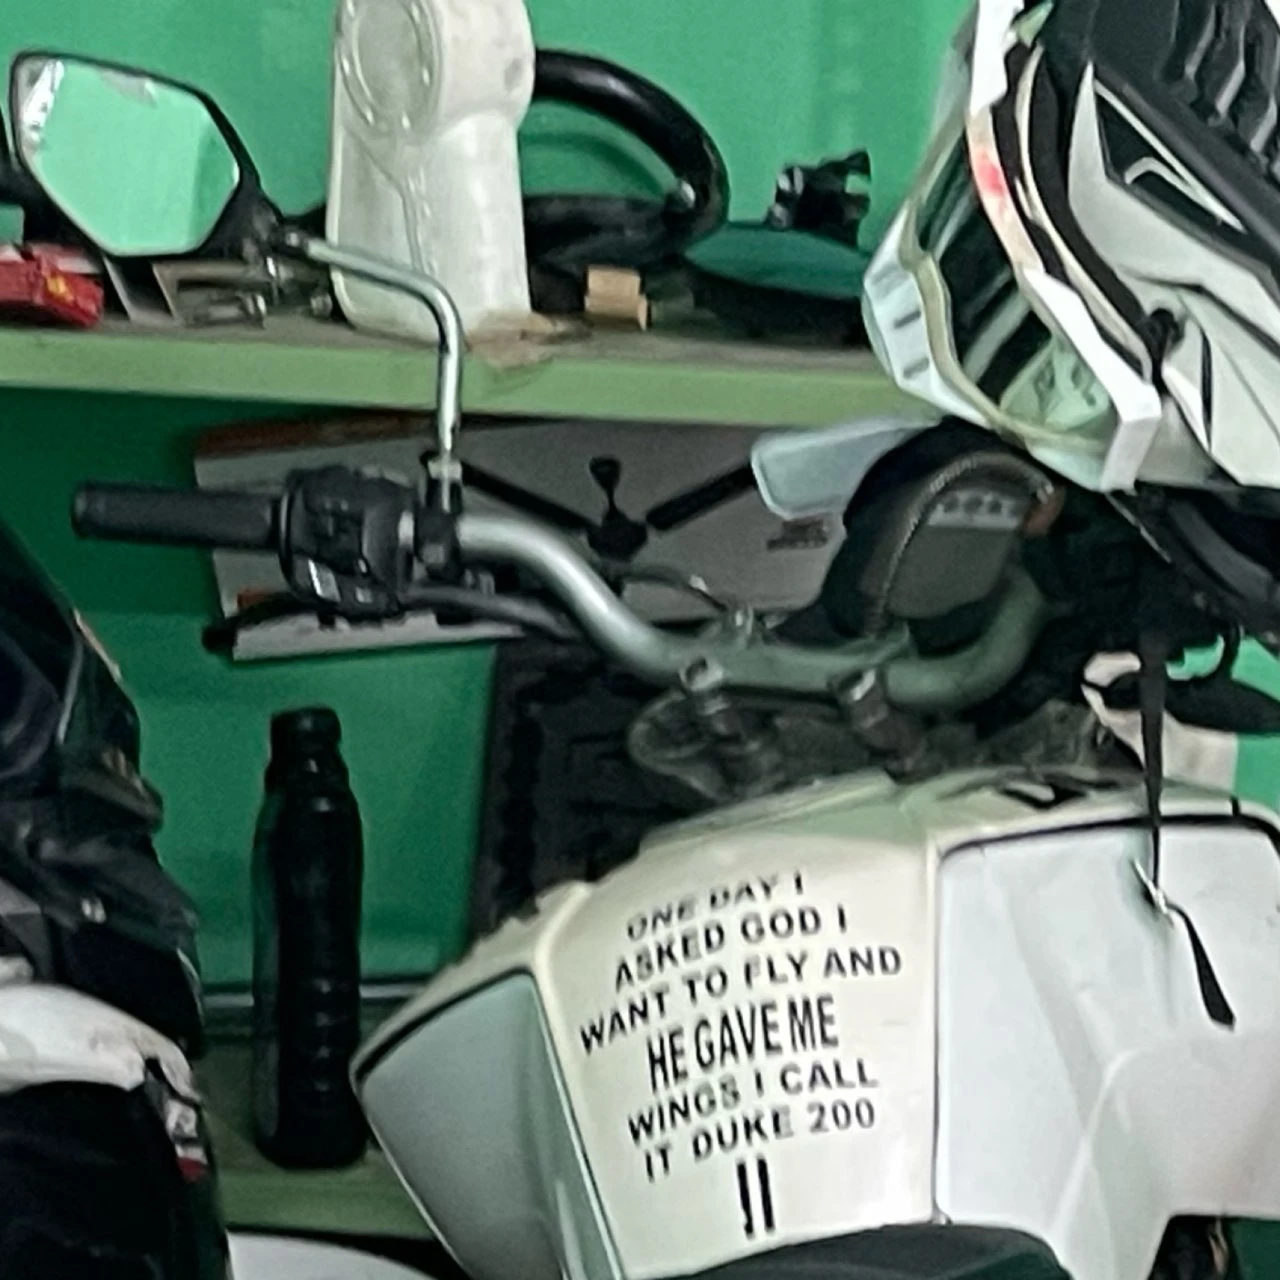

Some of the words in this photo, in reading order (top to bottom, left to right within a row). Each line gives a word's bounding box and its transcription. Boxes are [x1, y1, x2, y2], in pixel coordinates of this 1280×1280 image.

[616, 920, 725, 994] ASKED
[740, 907, 821, 945] GOD
[837, 903, 847, 934] I
[627, 897, 696, 941] ONE
[710, 874, 778, 910] DAY
[580, 981, 670, 1056] WANT
[681, 965, 728, 1006] TO
[744, 949, 808, 989] FLY
[823, 945, 901, 979] AND
[647, 1024, 688, 1094] HE
[694, 998, 783, 1073] GAVE
[787, 993, 839, 1052] ME
[628, 1074, 740, 1145] WINGS
[754, 1068, 764, 1097] I
[779, 1057, 879, 1095] CALL
[645, 1142, 670, 1183] IT
[692, 1104, 794, 1162] DUKE
[807, 1097, 875, 1133] 200
